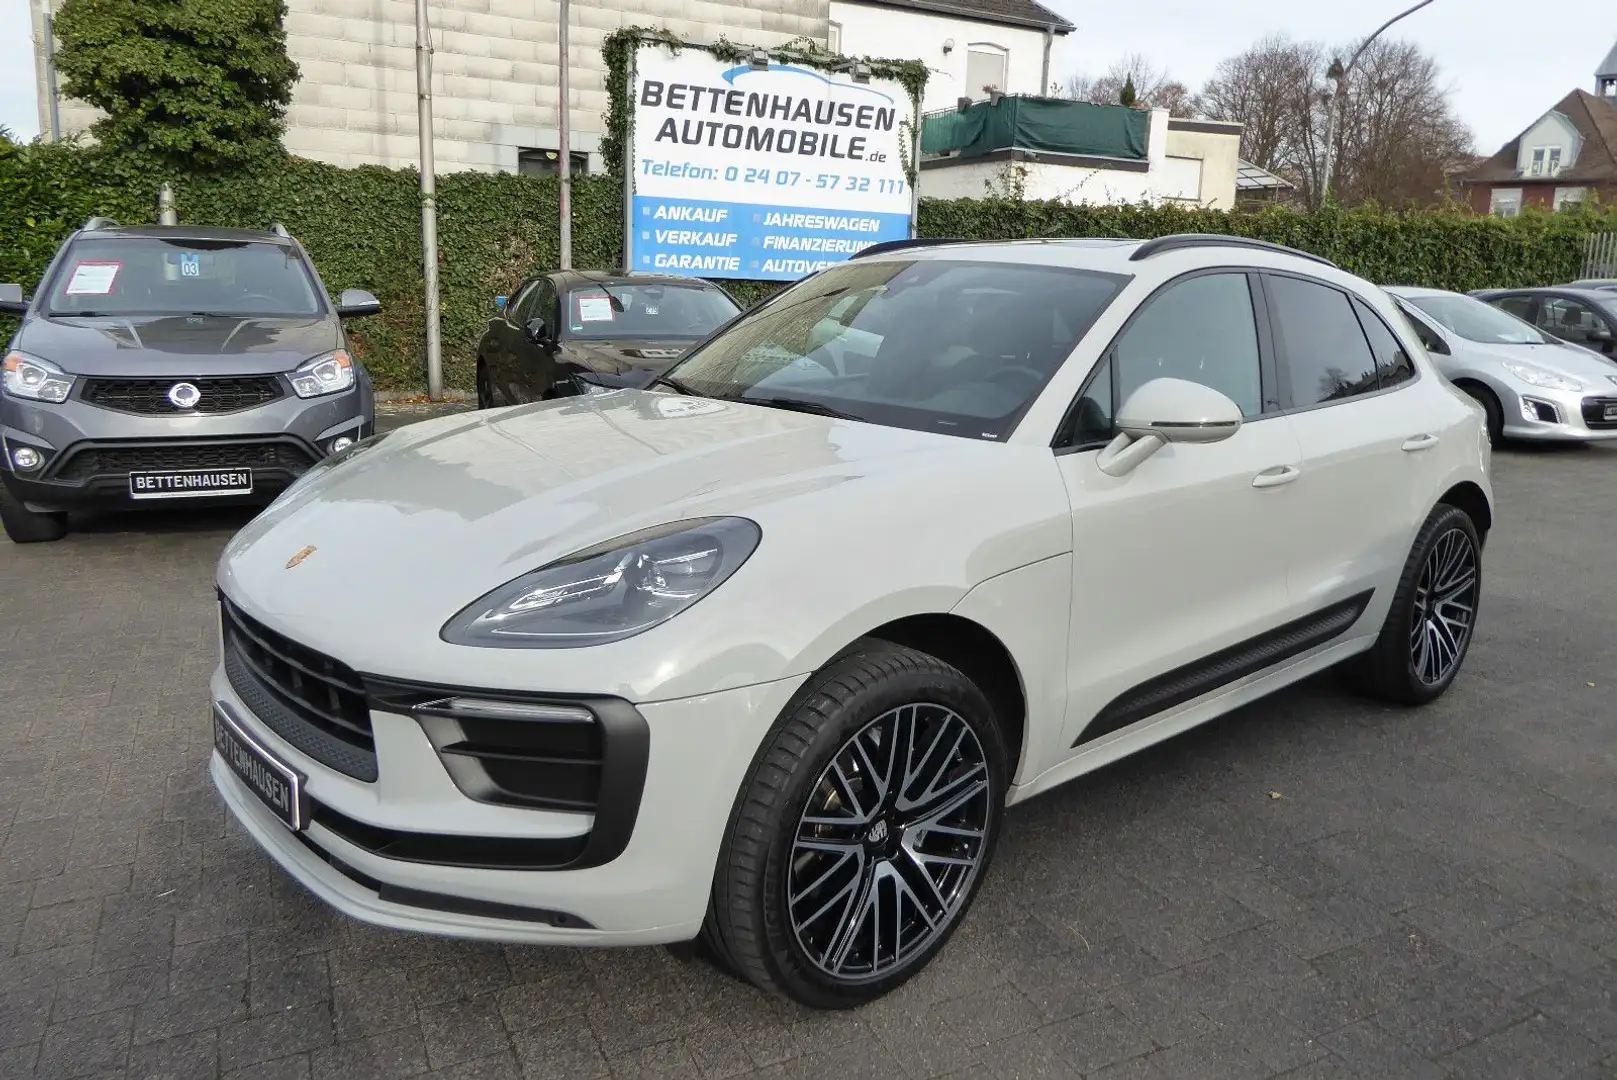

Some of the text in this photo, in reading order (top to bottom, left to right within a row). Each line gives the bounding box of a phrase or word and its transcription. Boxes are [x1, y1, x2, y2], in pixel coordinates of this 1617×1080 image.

[640, 80, 896, 132] BETTENHAUSEN
[641, 159, 719, 181] Telefon:
[724, 166, 738, 182] 0
[747, 169, 770, 185] 24
[776, 171, 801, 187] 07
[815, 176, 840, 191] 57
[845, 178, 871, 193] 32
[878, 179, 904, 195] 111
[653, 205, 728, 223] ANKAUF
[763, 212, 880, 232] JAHRESWAGEN
[655, 229, 738, 247] VERKAUF
[184, 263, 197, 275] 03
[654, 254, 740, 272] GARANTIE
[136, 473, 247, 489] BETTENHAUSEN
[215, 722, 289, 812] BETTENHAUSEN
